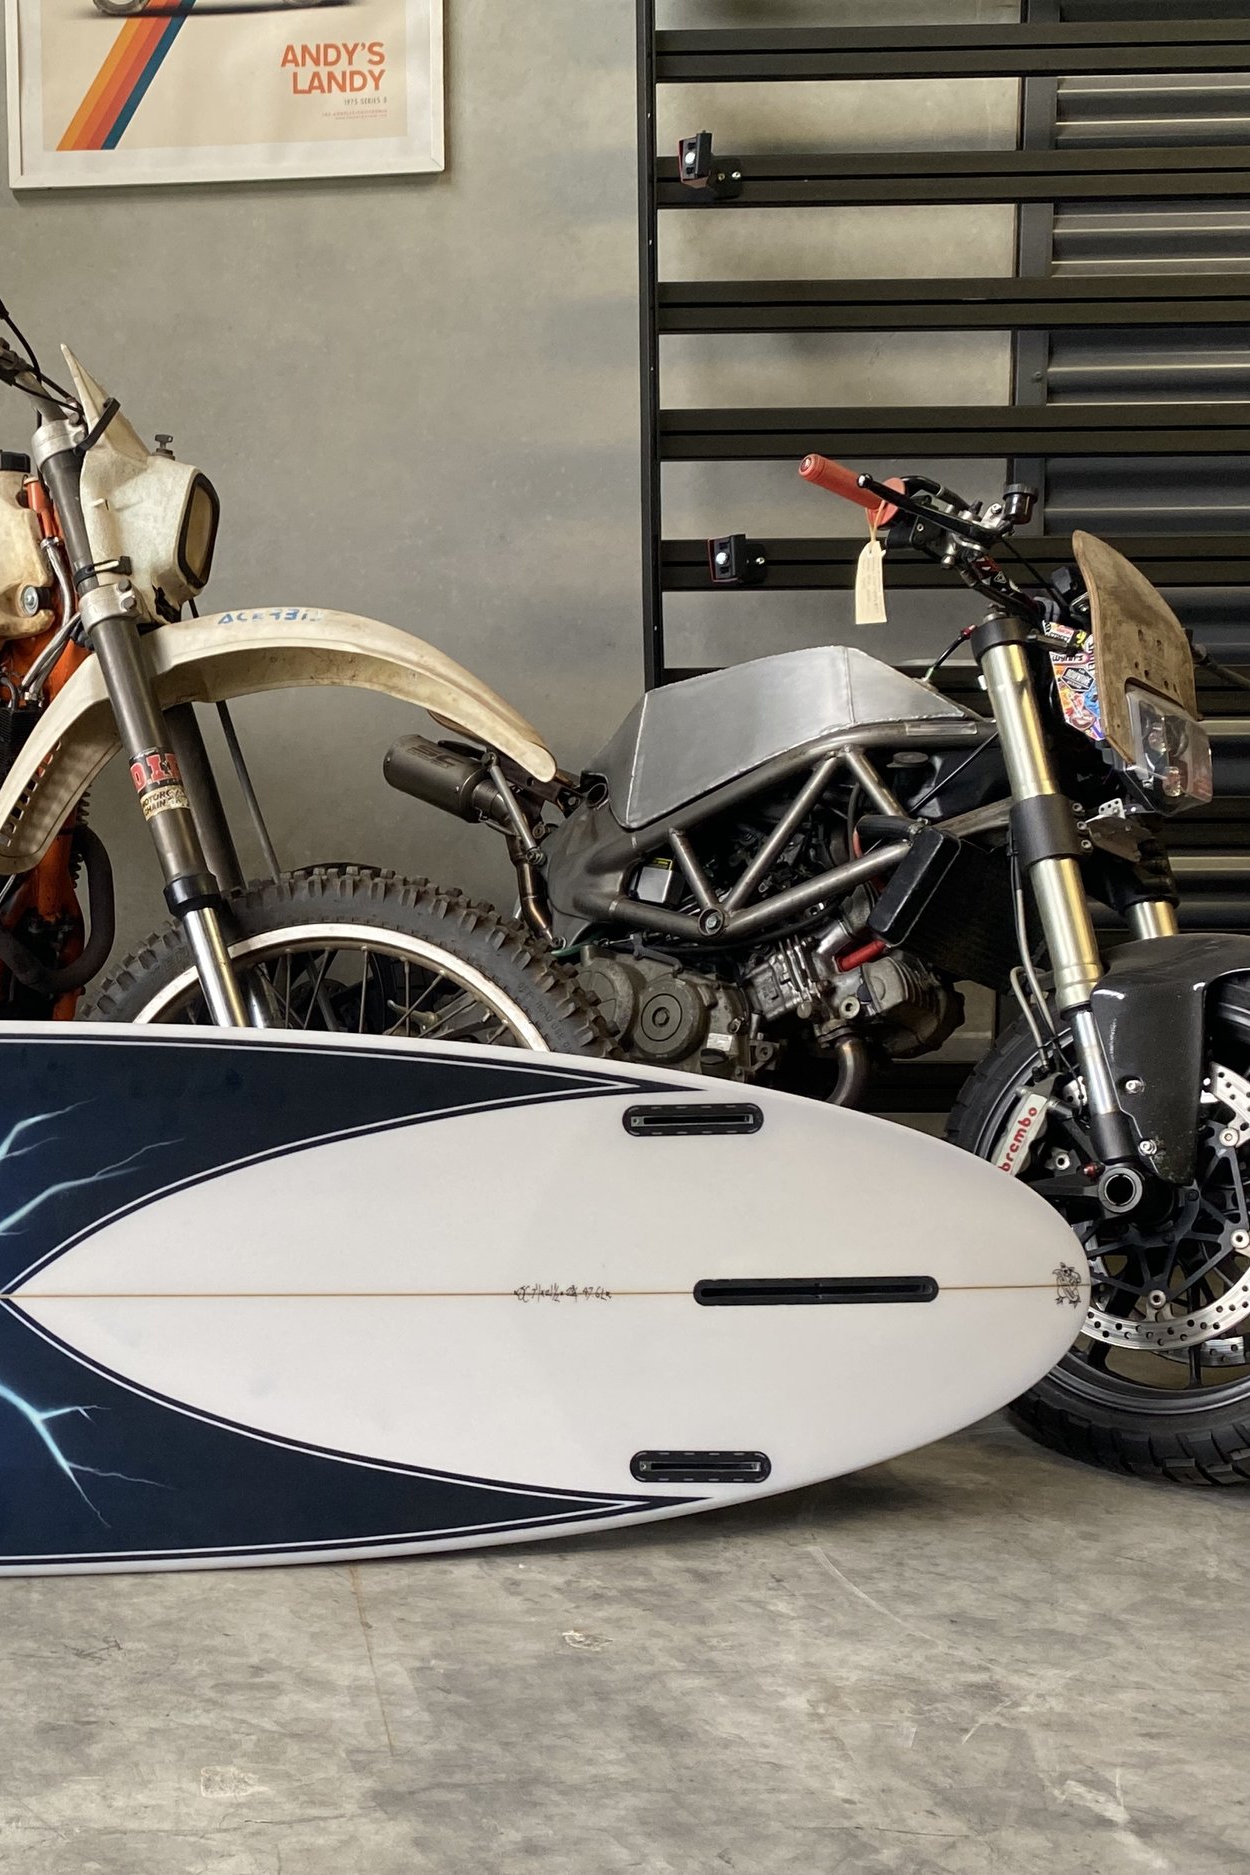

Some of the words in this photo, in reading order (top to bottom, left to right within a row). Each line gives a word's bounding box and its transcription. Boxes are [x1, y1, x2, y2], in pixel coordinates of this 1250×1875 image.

[281, 41, 386, 68] ANDY'S
[292, 69, 386, 95] LANDY
[997, 1106, 1038, 1173] brembo
